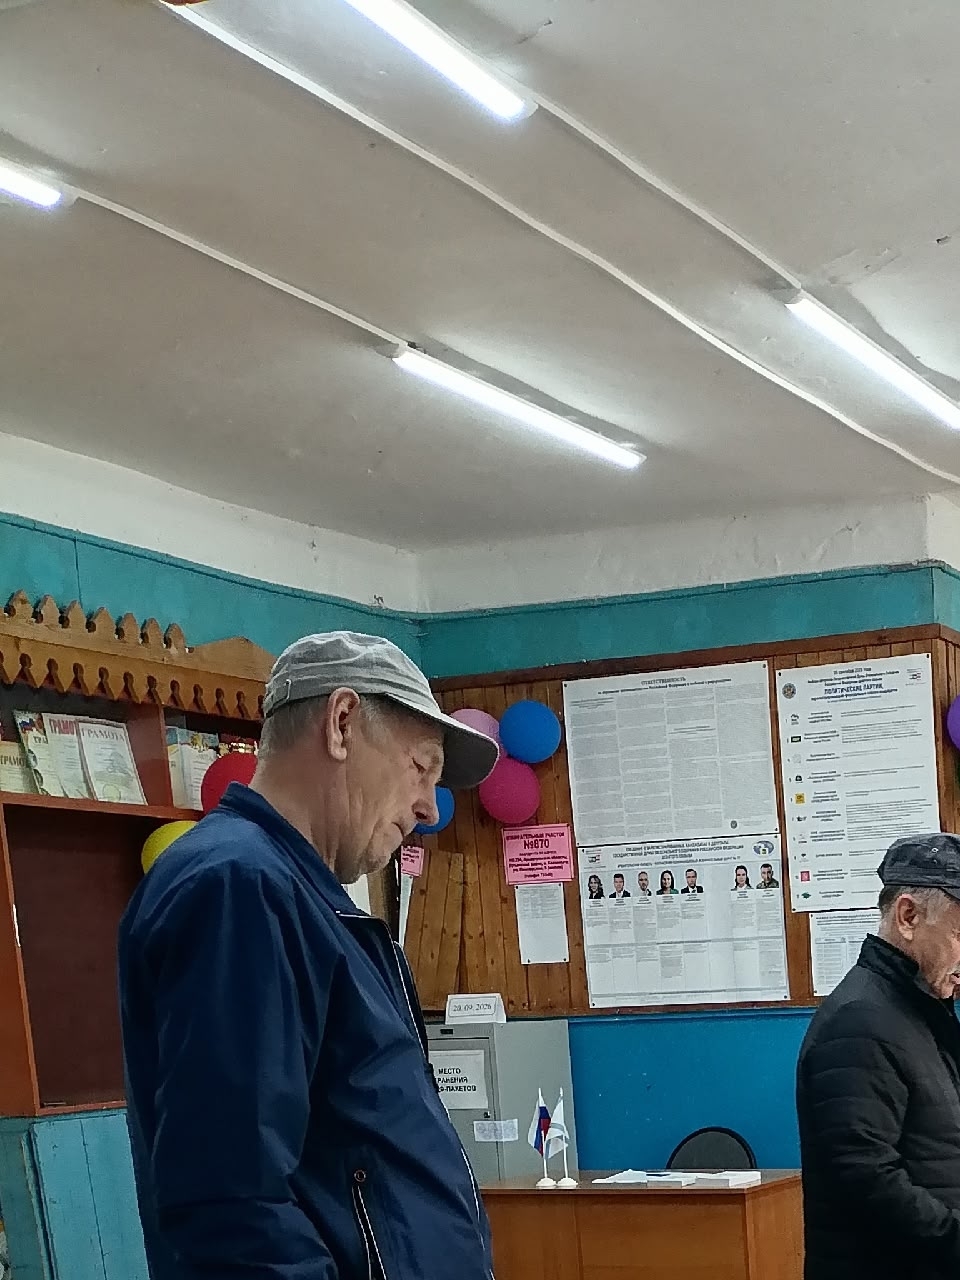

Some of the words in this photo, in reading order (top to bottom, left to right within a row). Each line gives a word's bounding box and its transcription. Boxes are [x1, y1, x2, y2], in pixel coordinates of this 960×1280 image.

[80, 727, 125, 741] ГРАМОТА
[0, 754, 25, 767] ГРАМО
[523, 839, 550, 849] №870
[438, 1067, 461, 1075] МЕСТО
[438, 1085, 477, 1093] Ф-ПАКЕТОВ
